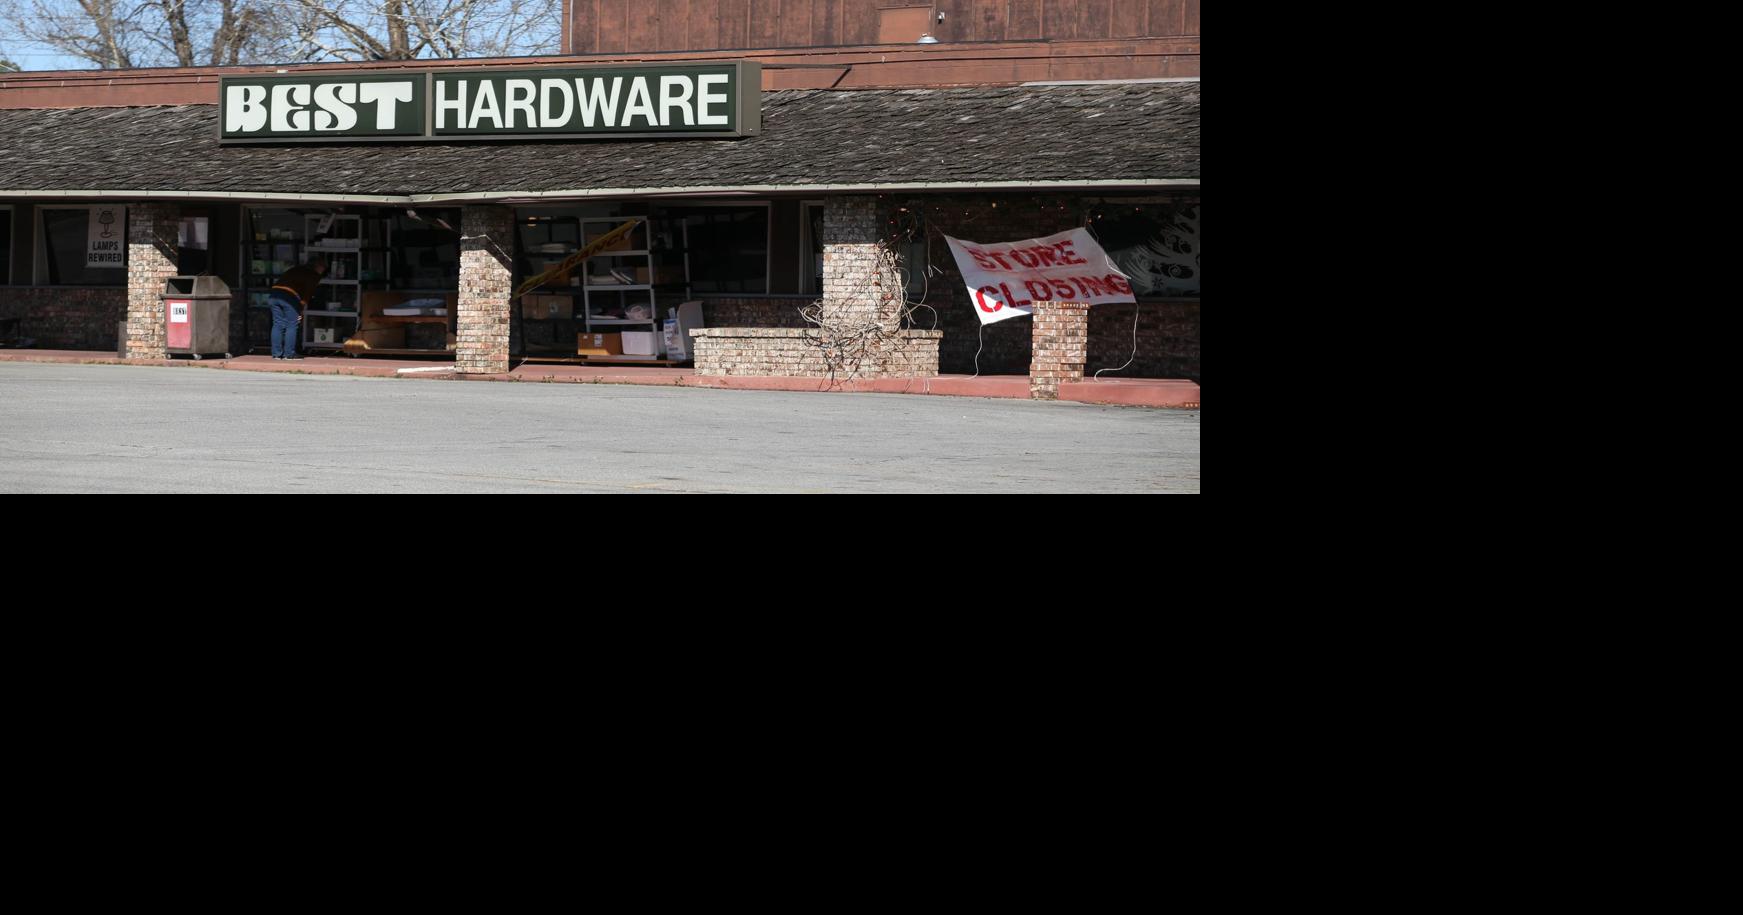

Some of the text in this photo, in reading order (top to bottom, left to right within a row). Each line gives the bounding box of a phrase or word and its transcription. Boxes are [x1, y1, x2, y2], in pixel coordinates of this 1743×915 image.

[226, 73, 729, 132] BEST HARDWARE
[88, 252, 122, 263] REWIRED
[92, 240, 119, 251] LAMPS
[967, 239, 1088, 271] STORE
[975, 273, 1133, 314] CLOSING
